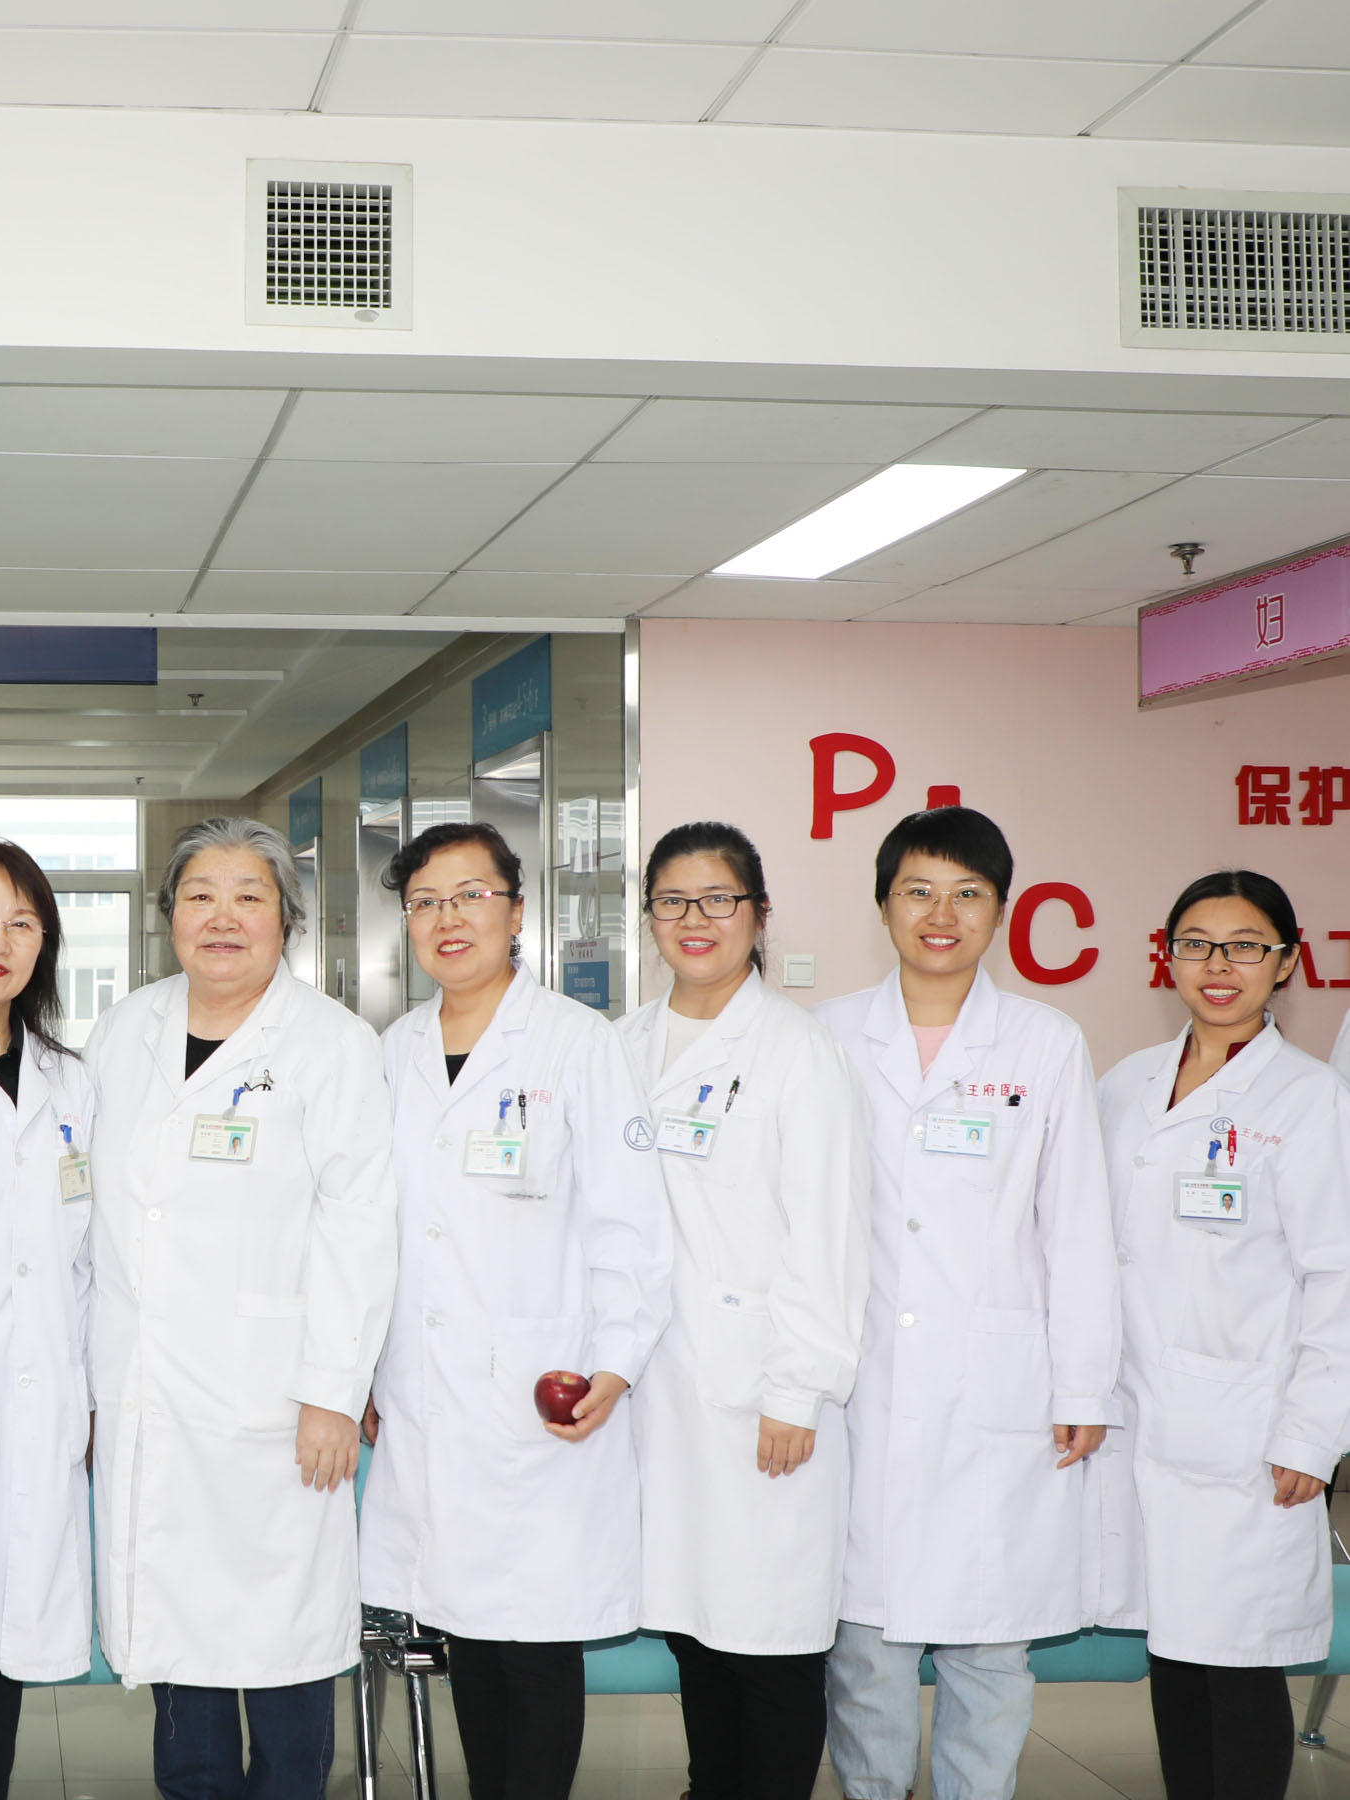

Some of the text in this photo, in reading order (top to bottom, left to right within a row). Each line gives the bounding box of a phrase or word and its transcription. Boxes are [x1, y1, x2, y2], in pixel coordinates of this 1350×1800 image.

[1254, 592, 1286, 650] 妇
[1235, 764, 1350, 826] 保护
[966, 1083, 1029, 1098] 王府医院
